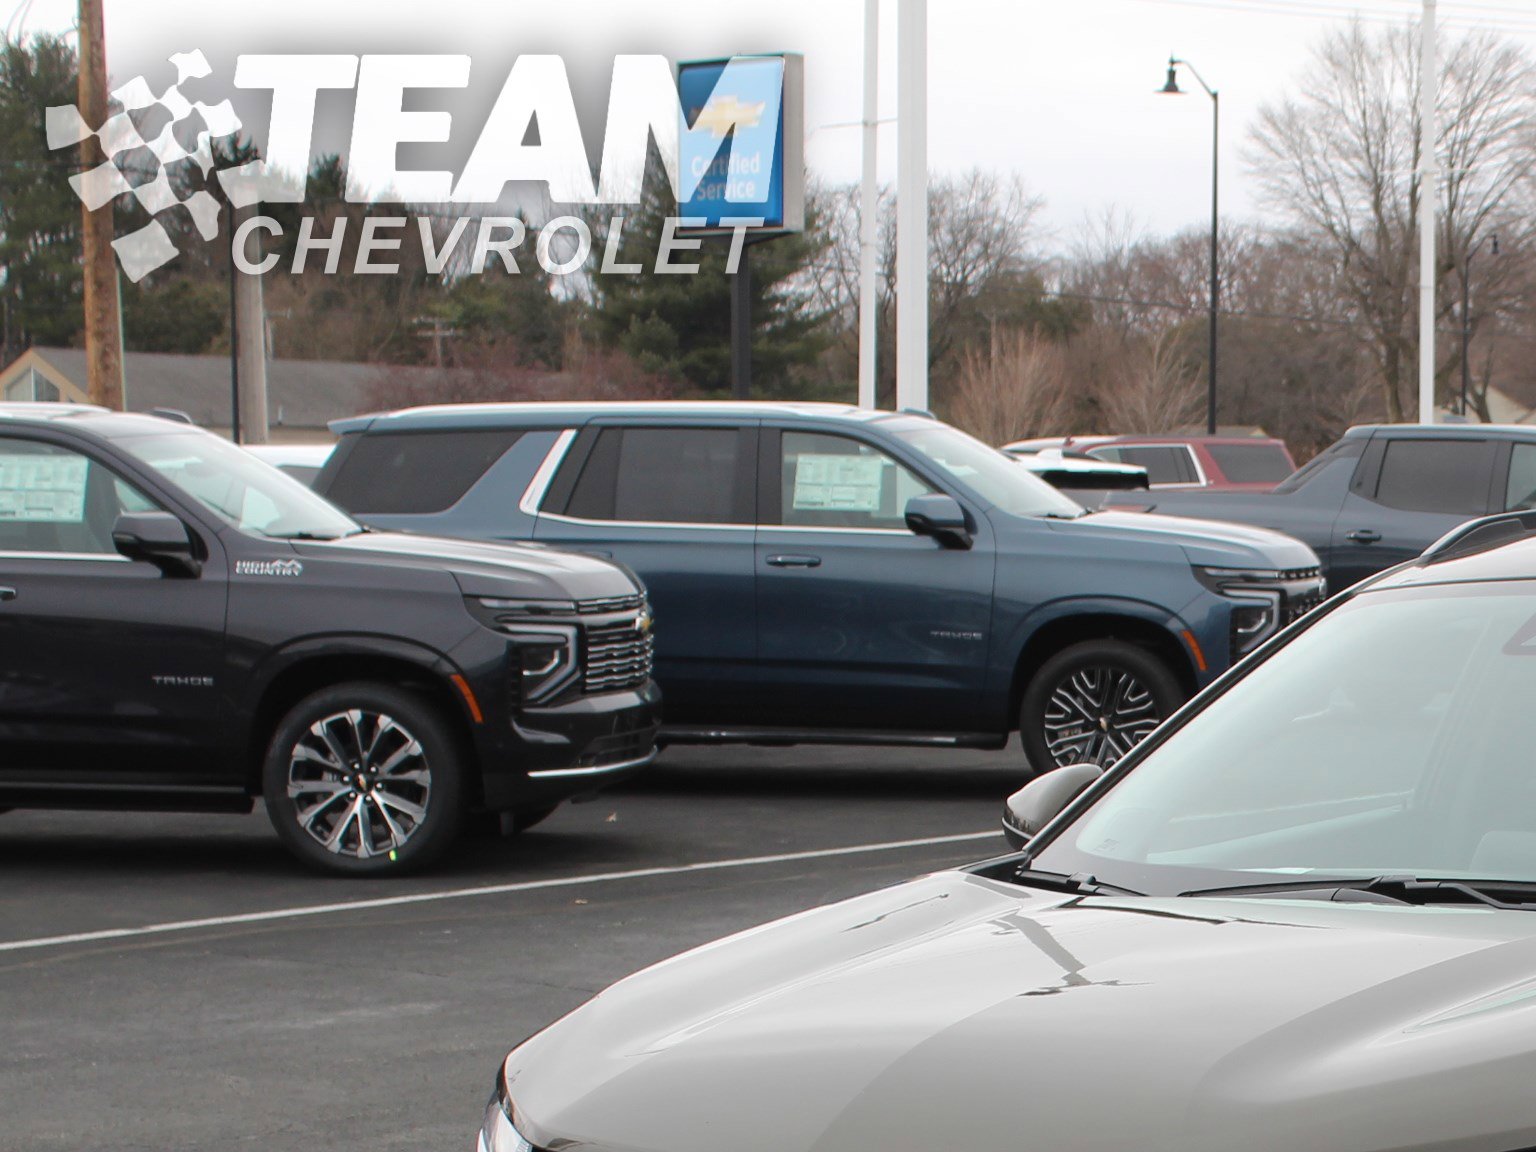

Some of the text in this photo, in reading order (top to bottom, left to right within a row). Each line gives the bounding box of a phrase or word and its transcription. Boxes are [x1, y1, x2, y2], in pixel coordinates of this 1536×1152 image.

[691, 152, 760, 177] Certified
[697, 179, 755, 200] Service
[152, 675, 214, 686] TAHOE
